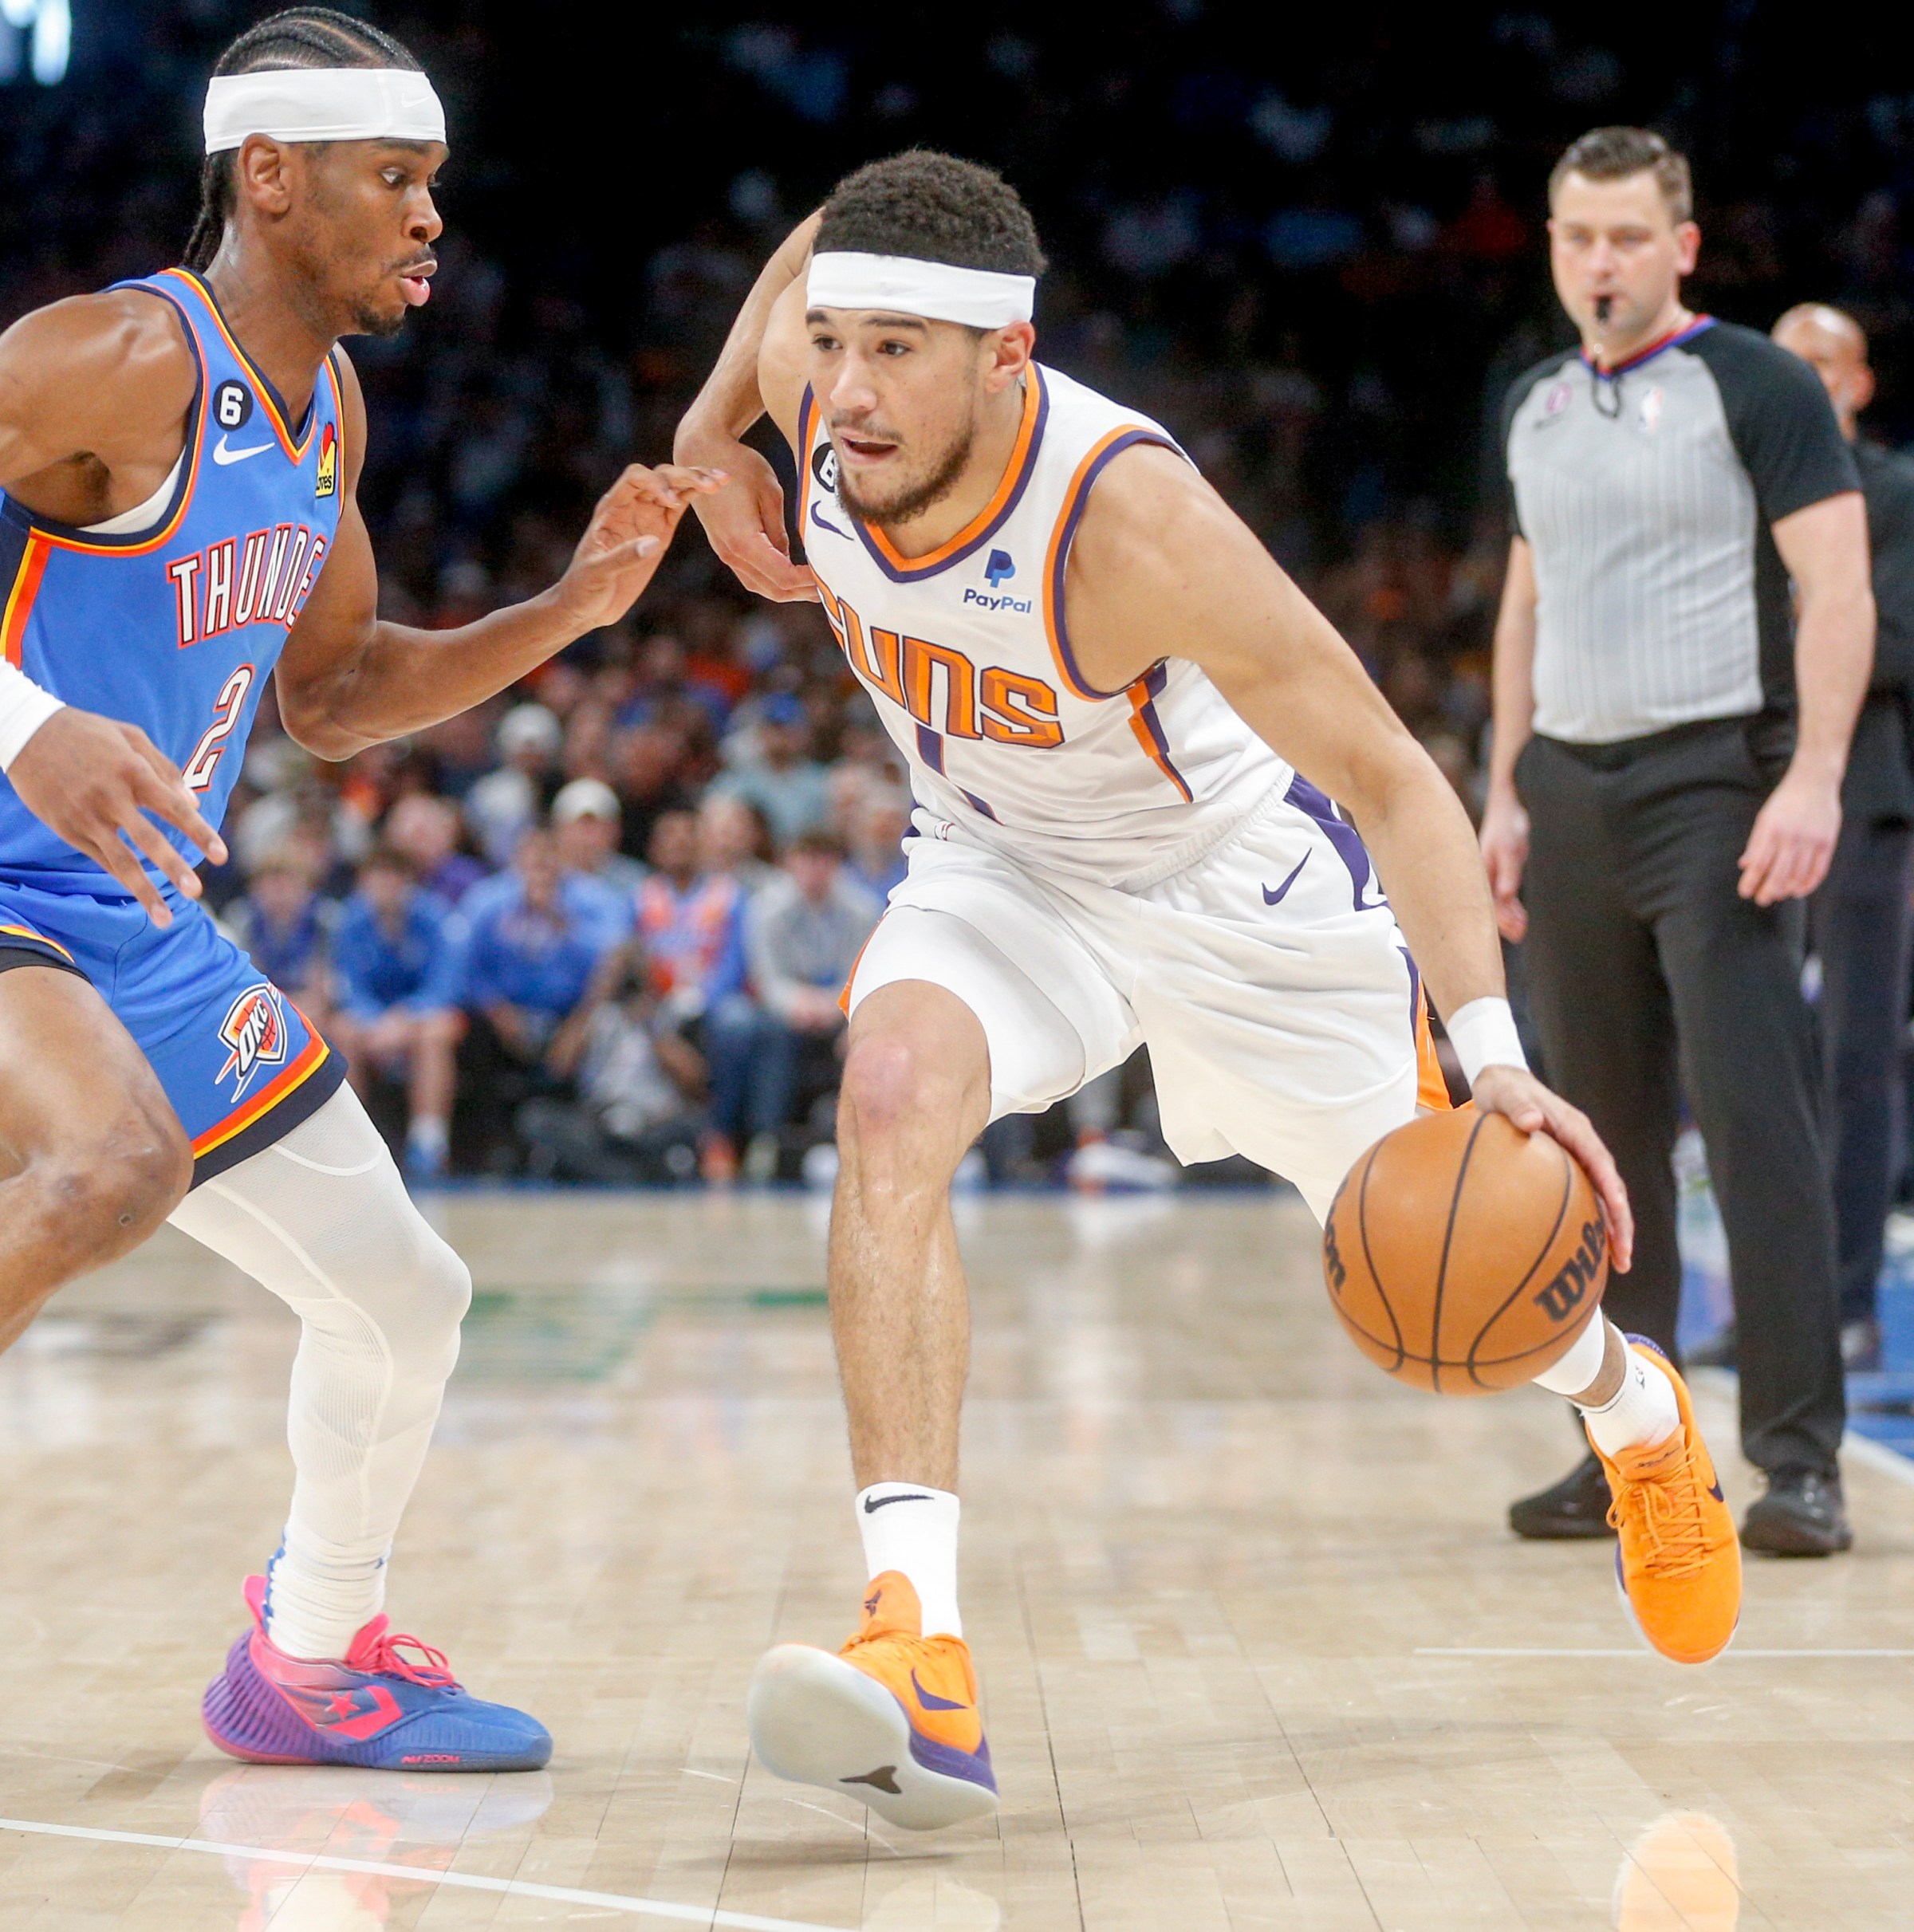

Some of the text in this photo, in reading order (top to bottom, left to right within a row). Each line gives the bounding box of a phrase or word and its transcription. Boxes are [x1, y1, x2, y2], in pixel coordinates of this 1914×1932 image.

[219, 385, 244, 426] 6
[166, 522, 328, 650] THUNDE
[963, 588, 1032, 614] PayPal
[182, 663, 255, 793] 2
[238, 997, 270, 1076] OKC
